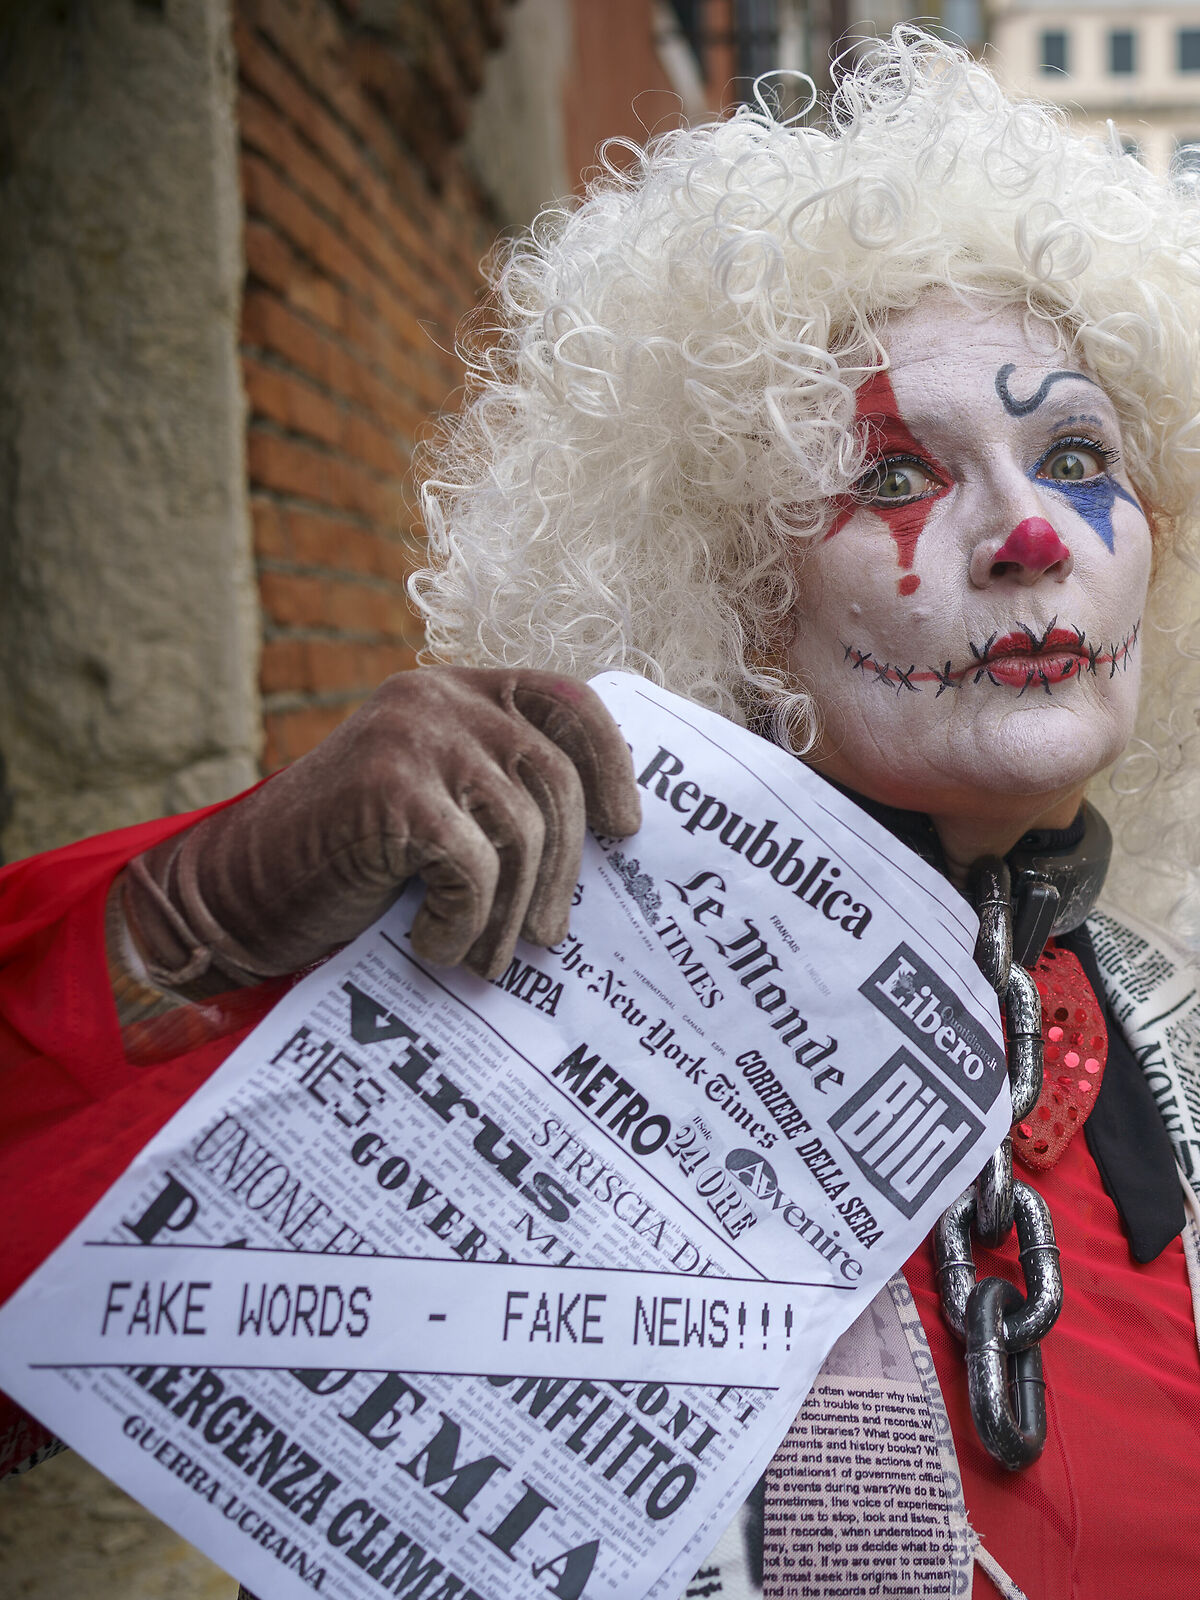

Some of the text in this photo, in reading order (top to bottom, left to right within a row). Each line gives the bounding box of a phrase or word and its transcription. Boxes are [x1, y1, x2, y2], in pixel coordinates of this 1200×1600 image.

[636, 745, 874, 940] Repubblica
[655, 915, 724, 1009] TIMES
[769, 914, 801, 953] FRANÇAIS
[489, 956, 564, 1017] MPA
[665, 870, 845, 1094] Le Monde
[682, 1014, 705, 1038] CANADA
[874, 956, 985, 1081] Libero
[587, 970, 648, 1028] New
[639, 1019, 708, 1084] York
[705, 1073, 779, 1149] Times
[342, 981, 581, 1224] Virus
[551, 1042, 672, 1156] METRO
[735, 1049, 884, 1249] CORRIERE DELLA SERA
[835, 1063, 972, 1202] Bild
[194, 1111, 332, 1249] UNIONE
[351, 1132, 520, 1263] GOVER
[531, 1119, 674, 1250] STRISCIA
[664, 1125, 757, 1241] 24 ORE
[101, 1281, 212, 1336] FAKE
[238, 1283, 372, 1338] WORDS
[503, 1291, 607, 1345] FAKE
[633, 1296, 793, 1351] NEWS!!!
[801, 1411, 860, 1424] documents
[862, 1413, 881, 1425] and
[818, 1386, 844, 1396] often
[848, 1386, 883, 1399] wonder
[886, 1391, 905, 1403] why
[823, 1398, 859, 1410] trouble
[862, 1401, 872, 1411] to
[875, 1404, 916, 1415] preserve
[123, 1367, 342, 1525] ERGENZA
[486, 1377, 698, 1521] NFLITTO
[802, 1453, 822, 1462] and
[826, 1455, 851, 1464] save
[855, 1455, 871, 1465] the
[875, 1456, 911, 1467] actions
[914, 1459, 923, 1468] of
[811, 1424, 861, 1437] libraries?
[863, 1428, 889, 1439] What
[893, 1431, 917, 1442] good
[919, 1435, 935, 1443] are
[826, 1440, 845, 1450] and
[850, 1440, 884, 1454] history
[887, 1443, 921, 1455] books?
[122, 1414, 220, 1504] GUERRA
[223, 1495, 329, 1591] UCRAINA
[784, 1481, 821, 1492] events
[825, 1481, 859, 1495] during
[914, 1486, 927, 1496] do
[831, 1496, 849, 1507] the
[853, 1496, 881, 1507] voice
[884, 1498, 894, 1508] of
[841, 1468, 852, 1478] of
[855, 1470, 916, 1481] government
[791, 1526, 837, 1539] records,
[841, 1526, 871, 1537] when
[873, 1527, 933, 1538] understood
[936, 1528, 945, 1538] in
[793, 1543, 813, 1552] can
[817, 1541, 842, 1555] help
[845, 1543, 859, 1551] us
[862, 1541, 898, 1551] decide
[901, 1541, 927, 1551] what
[930, 1541, 940, 1551] to
[801, 1513, 814, 1521] us
[817, 1511, 829, 1521] to
[832, 1512, 859, 1524] stop,
[863, 1511, 886, 1522] look
[889, 1513, 908, 1522] and
[782, 1571, 811, 1581] must
[814, 1571, 842, 1582] seek
[861, 1570, 898, 1583] origins
[901, 1570, 911, 1580] in
[914, 1570, 950, 1581] human
[784, 1556, 796, 1567] to
[831, 1558, 849, 1567] we
[851, 1558, 870, 1567] are
[873, 1558, 896, 1567] ever
[900, 1556, 910, 1566] to
[913, 1556, 946, 1566] create
[787, 1587, 798, 1597] in
[802, 1585, 821, 1597] the
[824, 1585, 866, 1597] records
[869, 1585, 880, 1596] of
[882, 1585, 920, 1596] human
